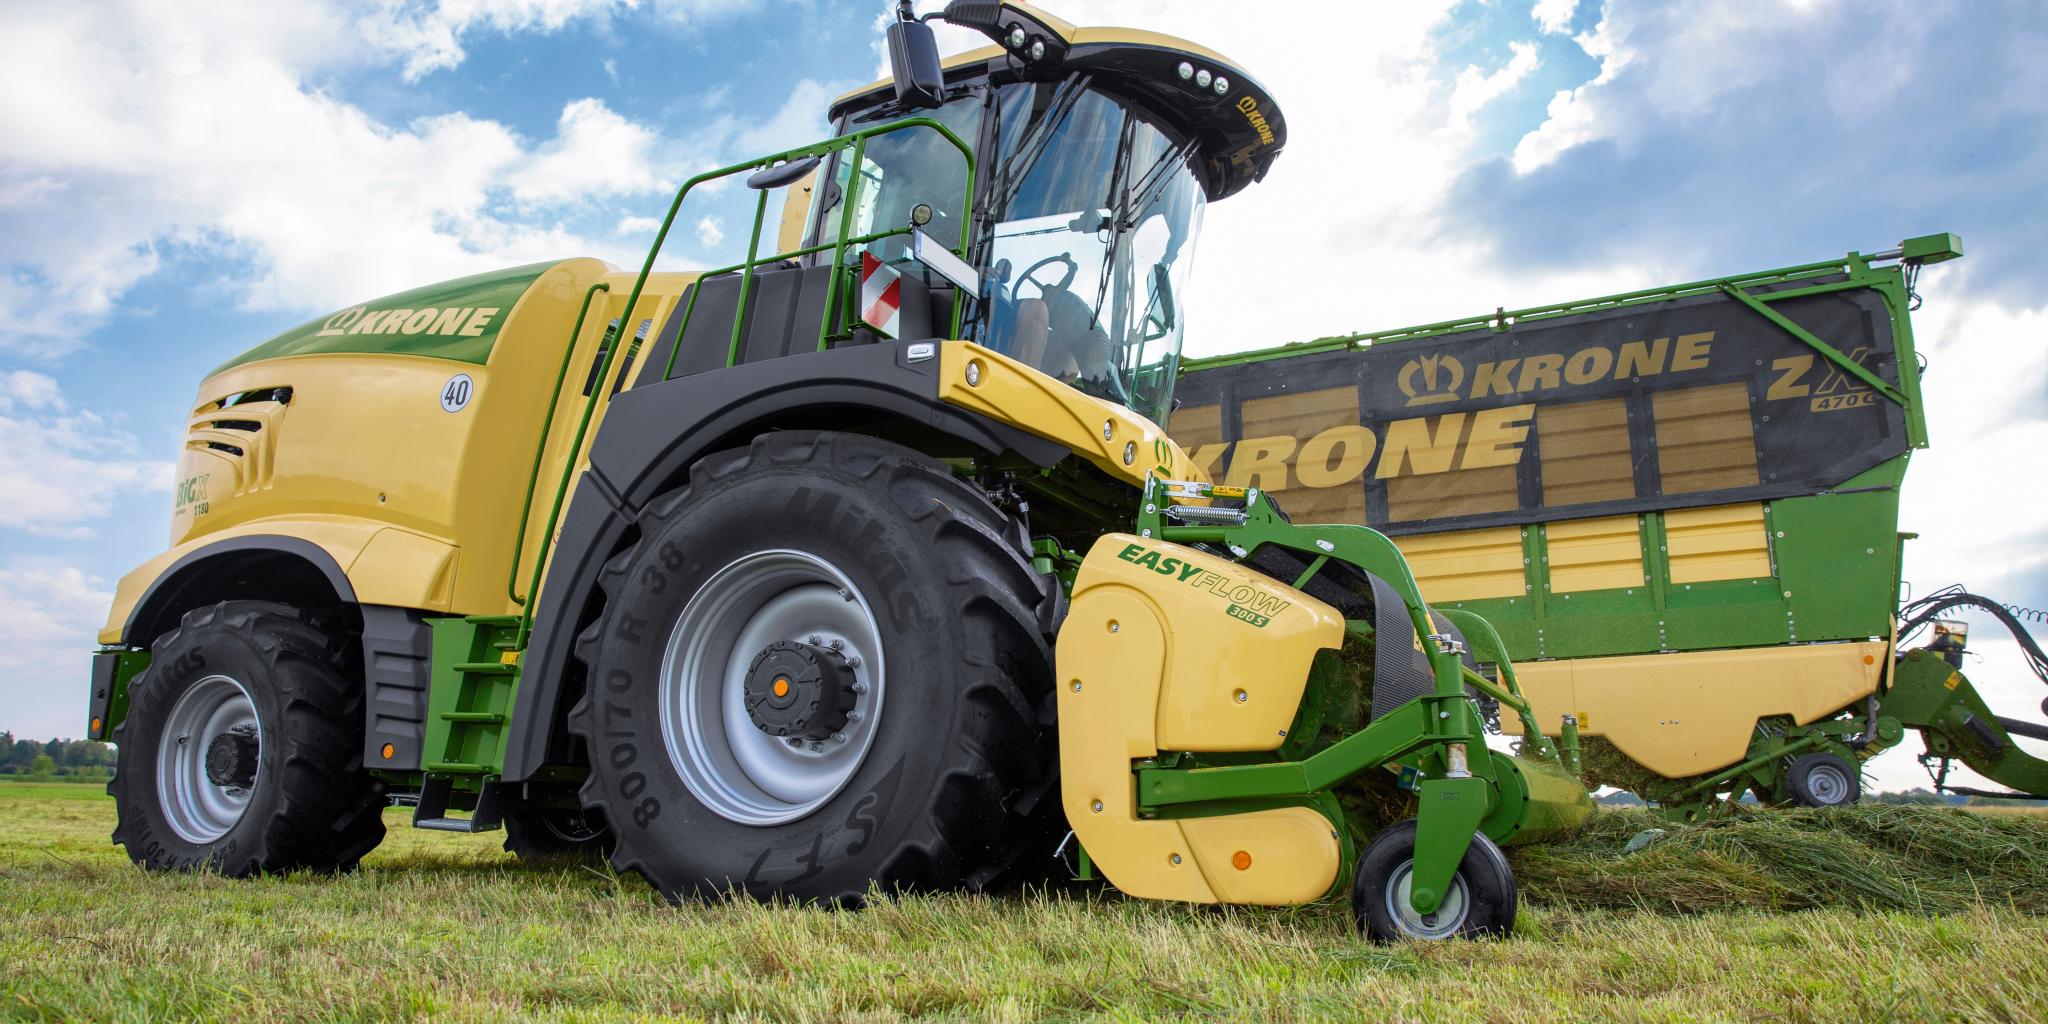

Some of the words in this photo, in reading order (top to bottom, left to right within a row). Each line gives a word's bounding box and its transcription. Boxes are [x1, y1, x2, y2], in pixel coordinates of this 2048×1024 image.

[1246, 110, 1274, 145] KRONE
[349, 307, 499, 336] KRONE
[1470, 331, 1715, 399] KRONE
[444, 379, 469, 406] 40
[1817, 395, 1858, 410] 470
[774, 486, 924, 635] Mitas
[615, 611, 648, 643] R
[642, 540, 685, 594] 38
